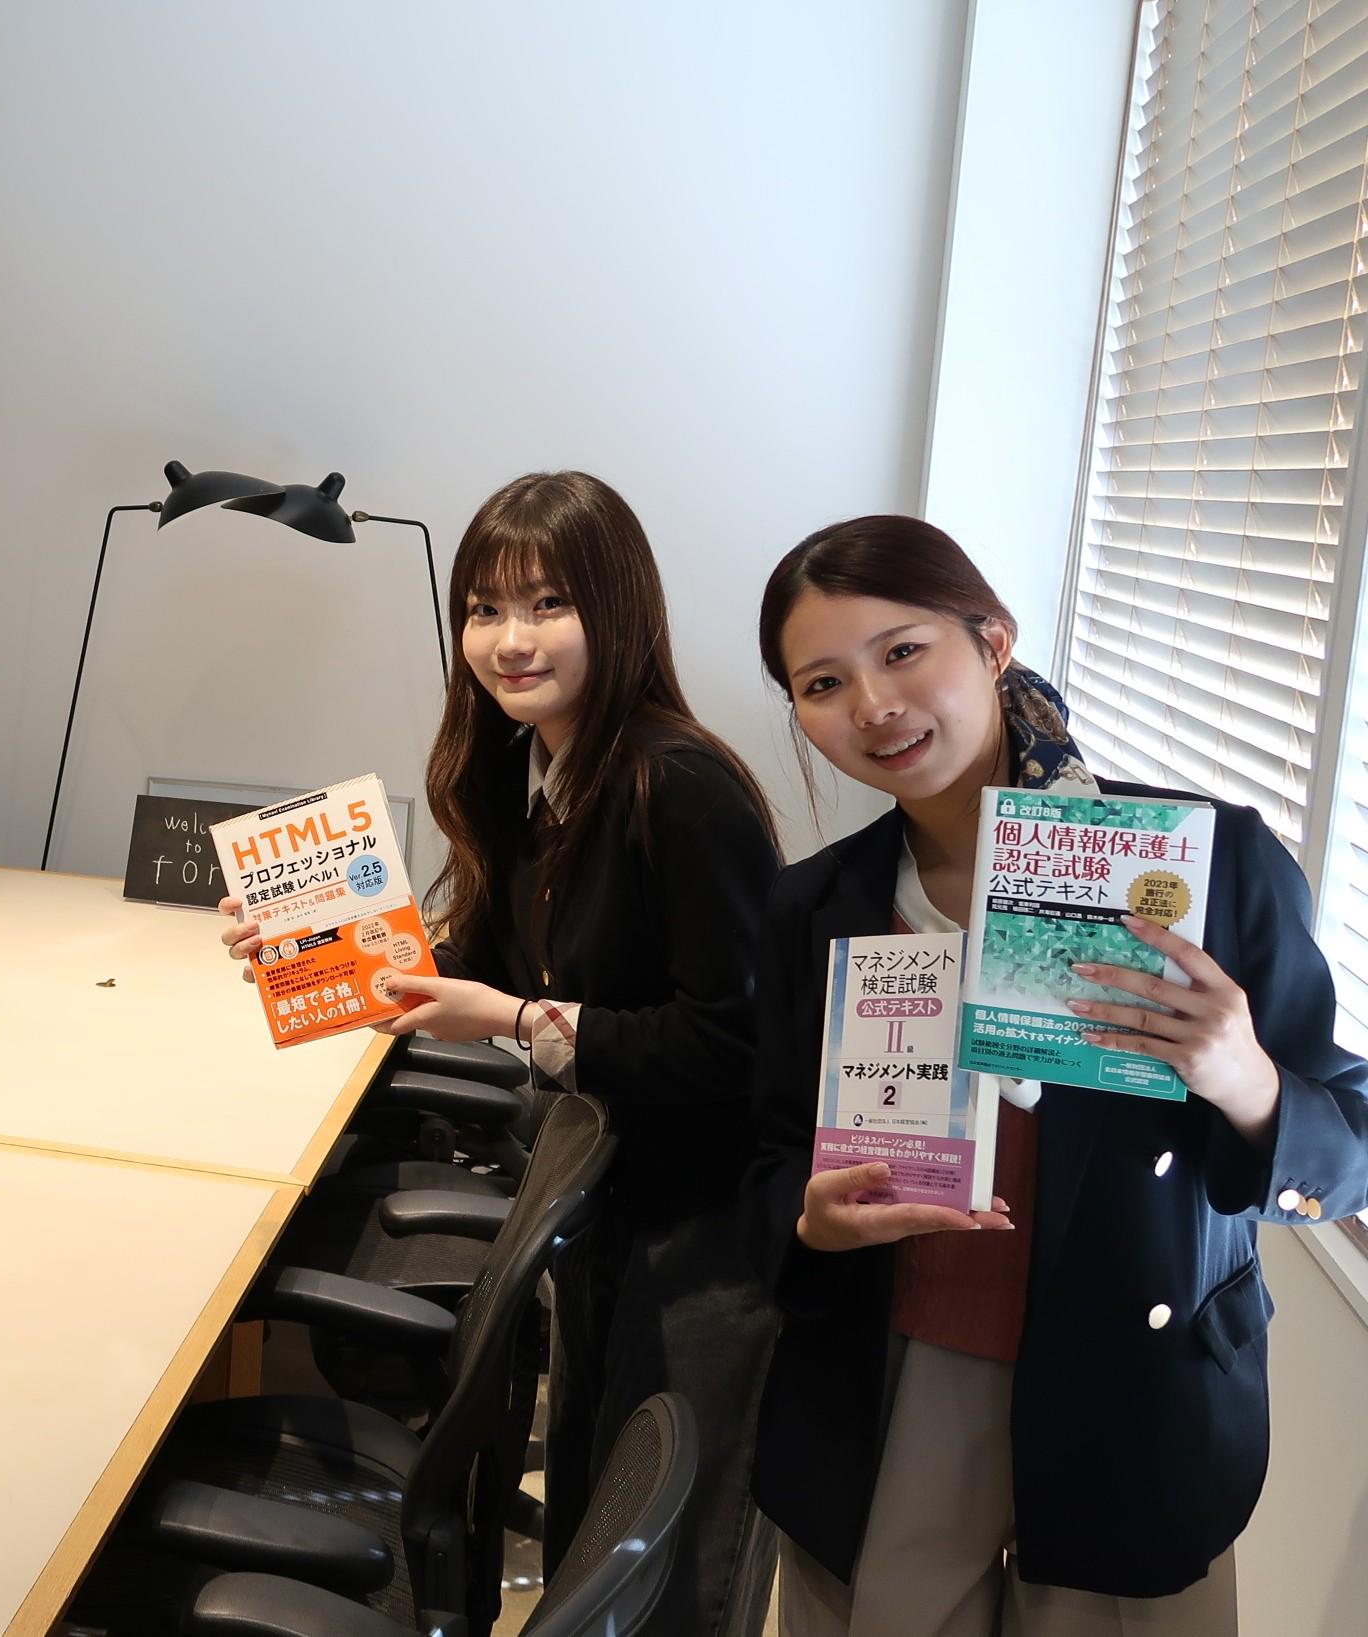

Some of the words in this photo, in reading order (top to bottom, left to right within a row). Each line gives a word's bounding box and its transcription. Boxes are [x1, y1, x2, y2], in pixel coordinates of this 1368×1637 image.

[185, 840, 202, 854] to
[992, 819, 1200, 864] 個人情報保護士
[239, 834, 377, 889] プロフェッショナル
[991, 847, 1113, 884] 認定試験
[245, 880, 296, 907] 認定試験
[297, 867, 340, 889] レベル1
[355, 876, 385, 892] 対応版
[988, 873, 1110, 905] 公式テキスト
[1143, 878, 1179, 890] 2023年
[392, 939, 409, 949] HTML
[394, 945, 412, 955] Living
[392, 949, 418, 961] Standard
[851, 948, 956, 973] マネジメント
[860, 973, 938, 996] 検定試験
[276, 996, 368, 1034] したい人の1冊!
[861, 1000, 938, 1016] 公式テキスト
[842, 1062, 949, 1082] マネジメント実践
[882, 1085, 897, 1107] 2
[850, 1134, 927, 1151] ビジネスパーソン必見!
